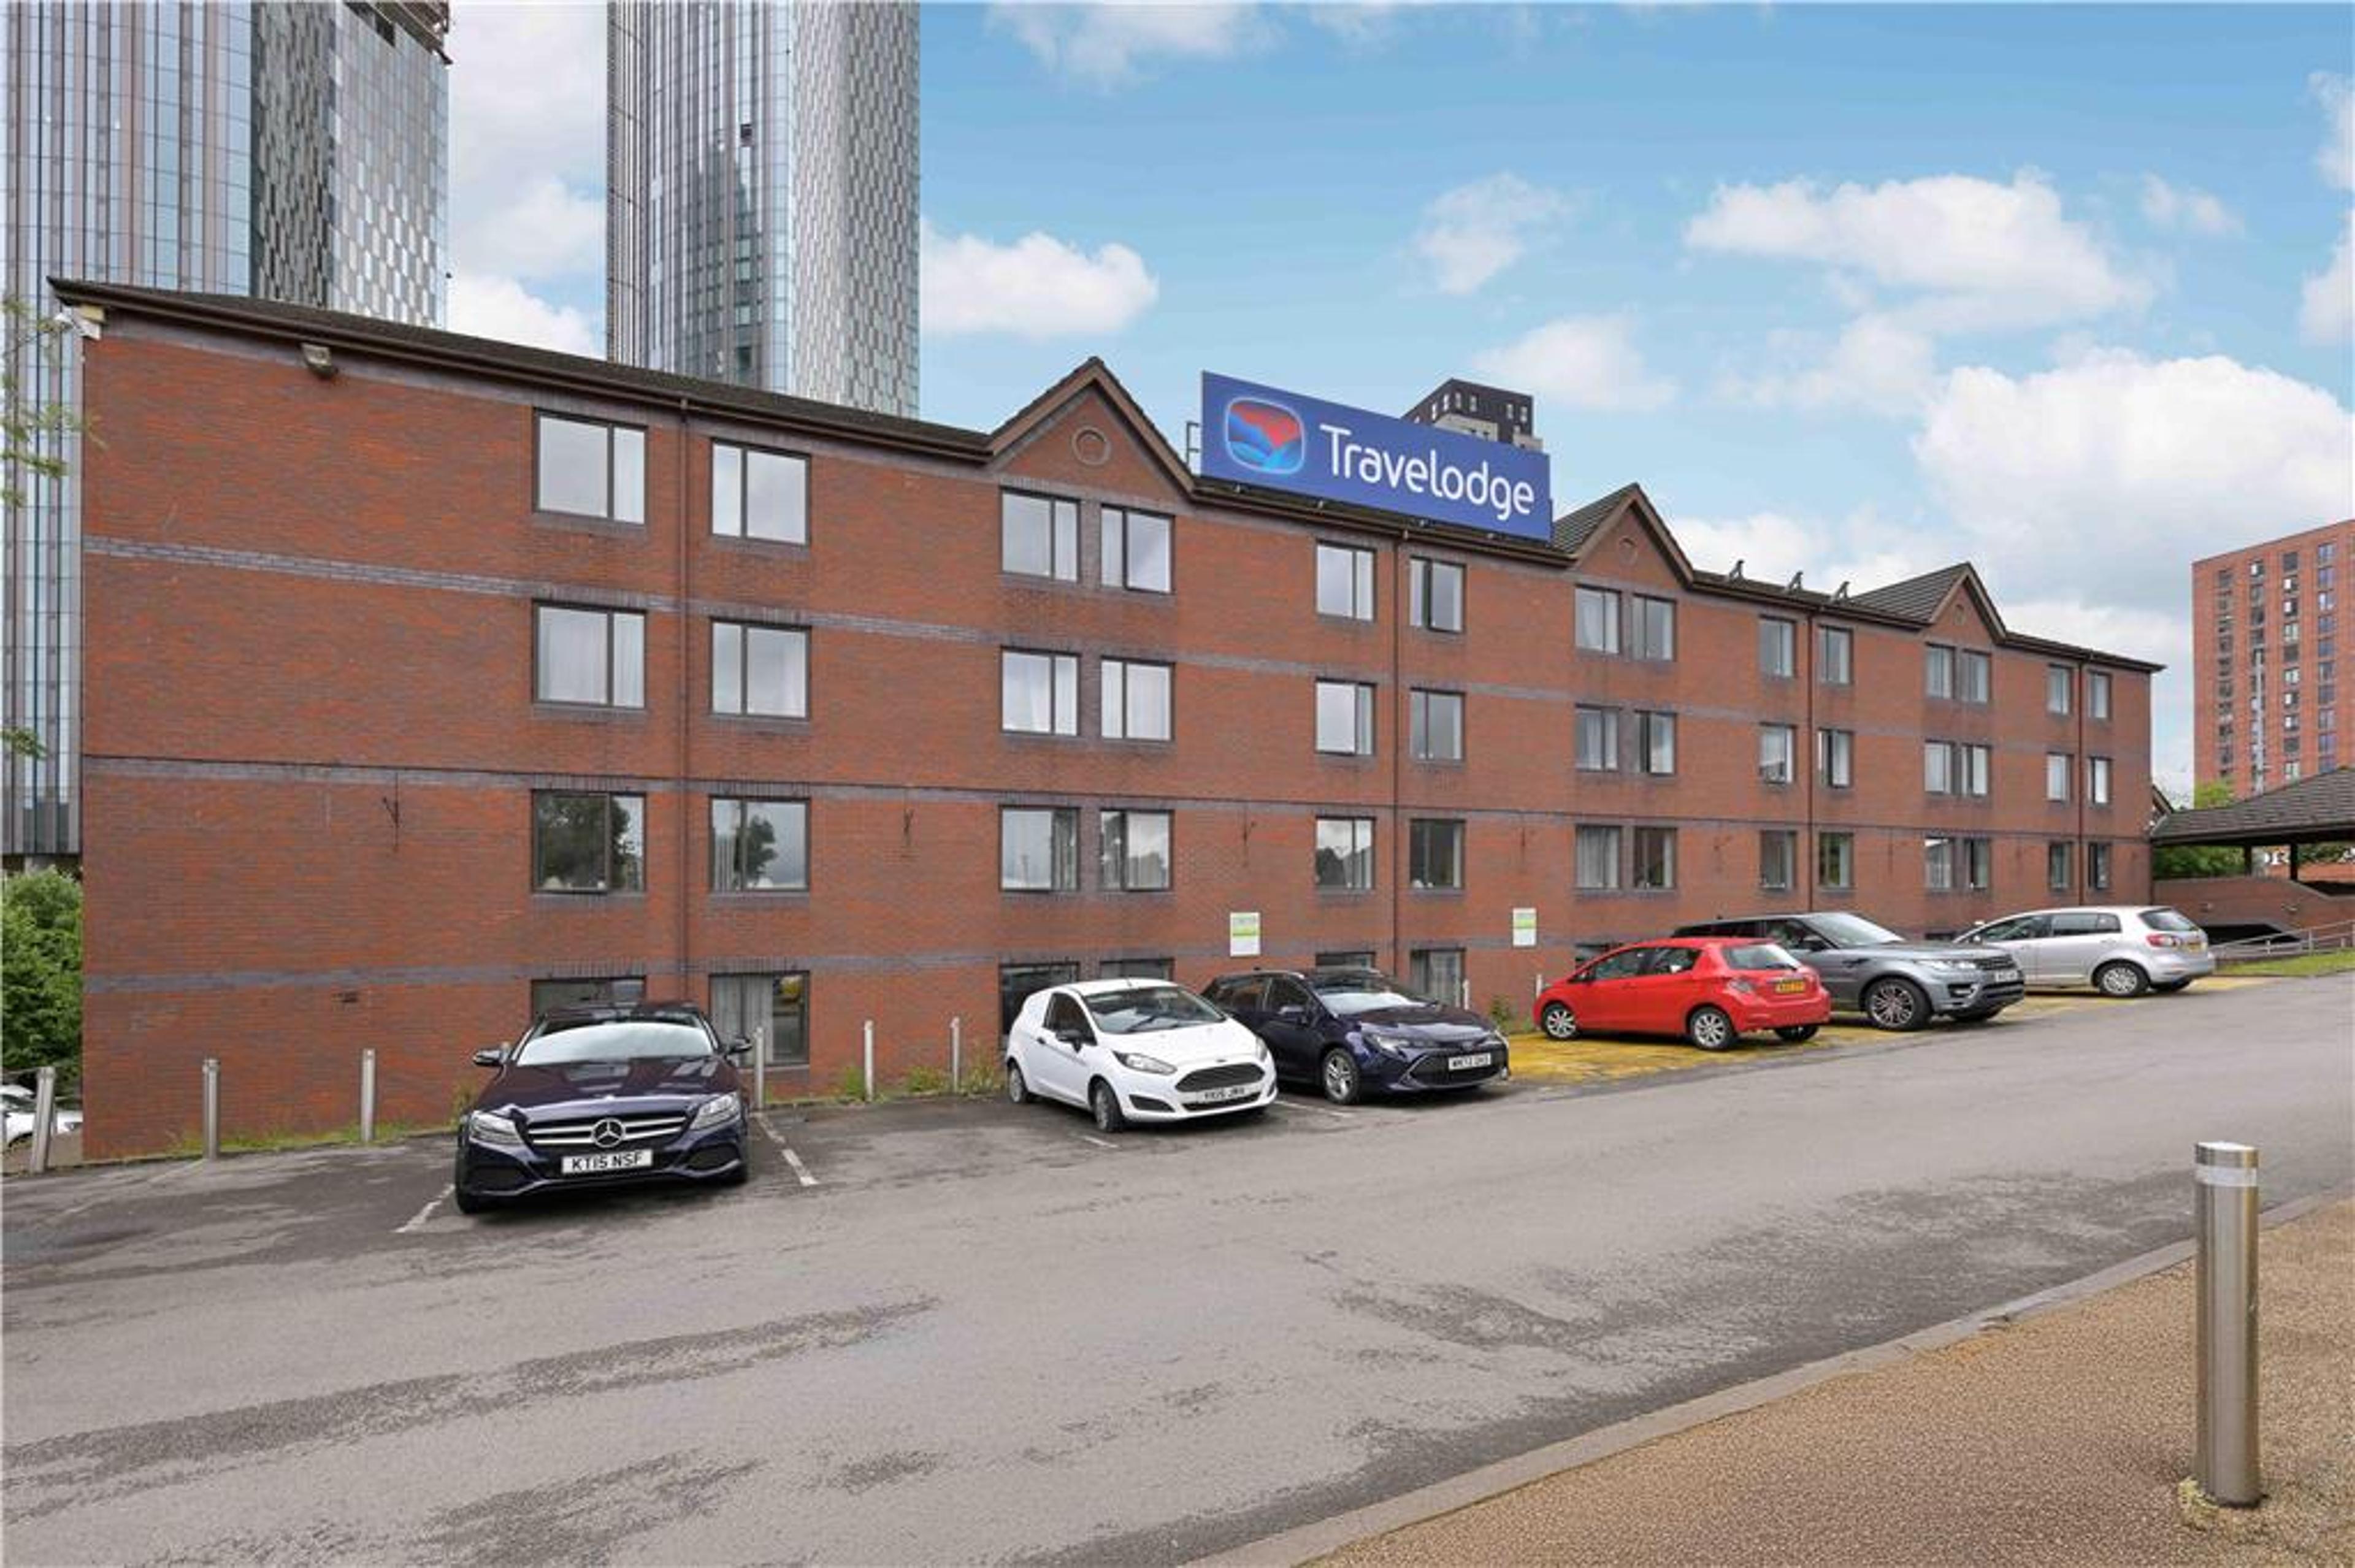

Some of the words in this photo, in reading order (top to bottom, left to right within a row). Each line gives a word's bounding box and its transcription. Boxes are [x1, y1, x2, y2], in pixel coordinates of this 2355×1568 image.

[1320, 424, 1534, 521] Travelodge
[572, 1155, 608, 1171] KT15
[613, 1149, 643, 1167] NSF
